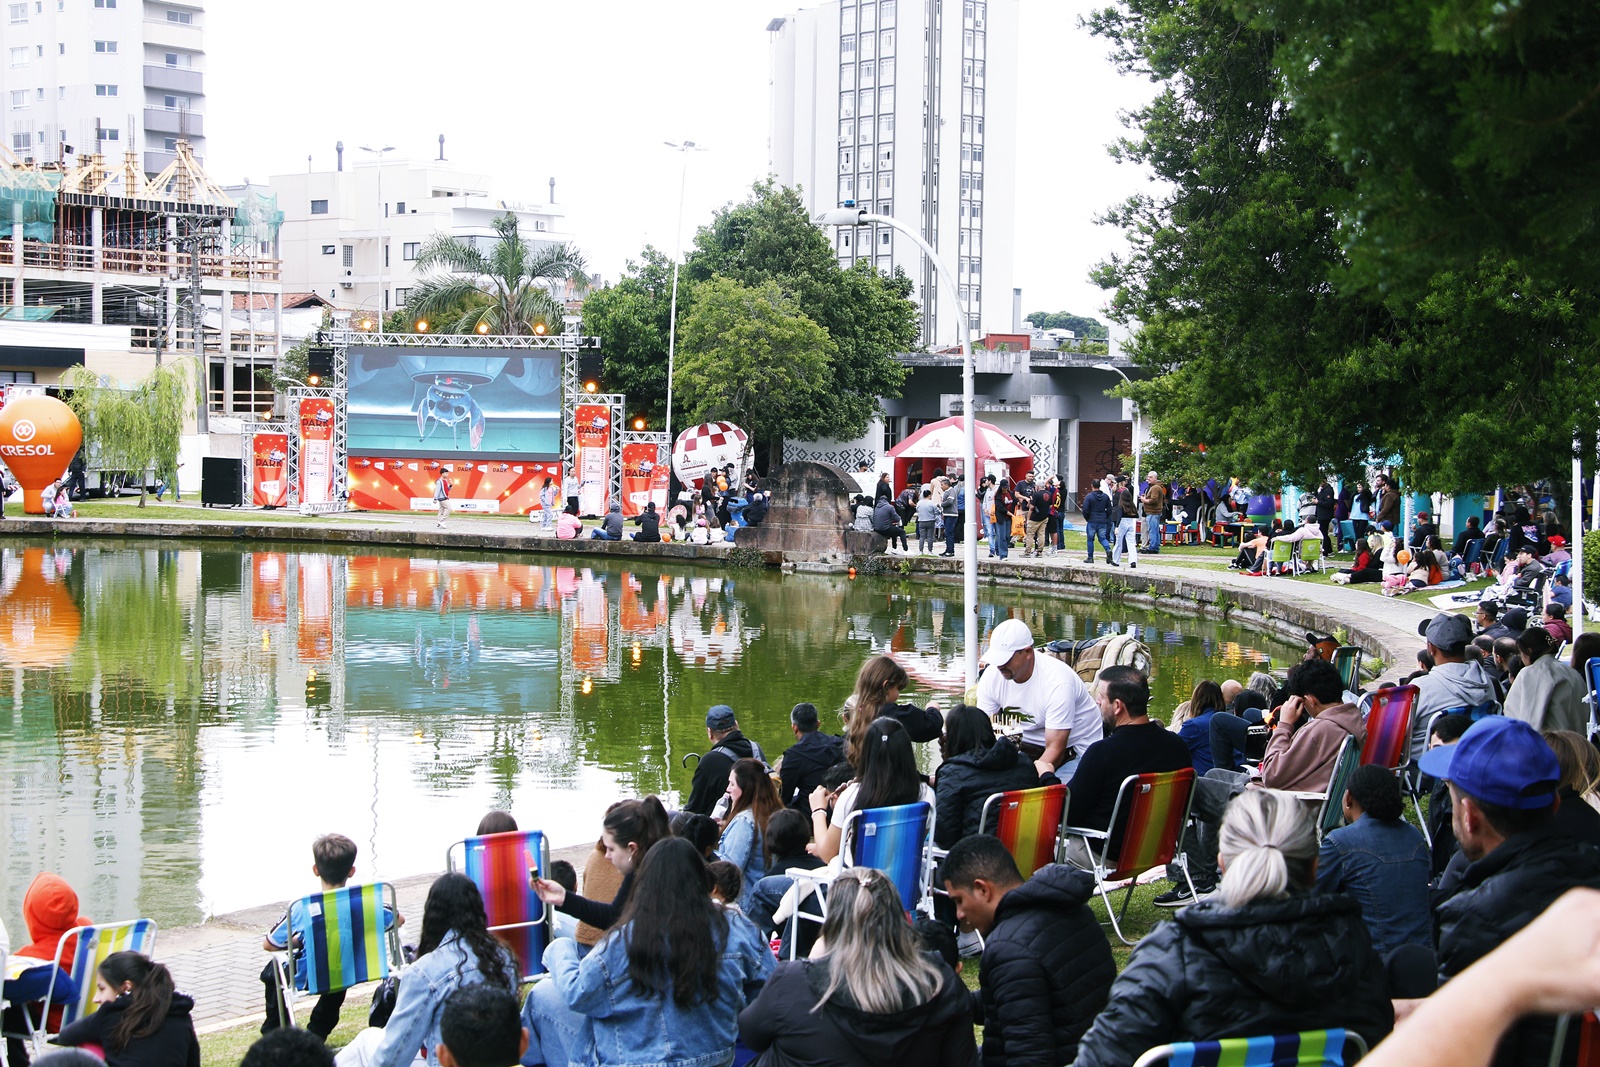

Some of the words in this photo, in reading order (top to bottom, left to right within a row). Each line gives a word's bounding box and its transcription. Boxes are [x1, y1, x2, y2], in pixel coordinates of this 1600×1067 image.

[302, 418, 329, 427] PARK
[577, 426, 605, 434] PARK
[0, 444, 55, 456] CRESOL
[255, 459, 283, 467] PARK
[625, 469, 651, 477] PARK
